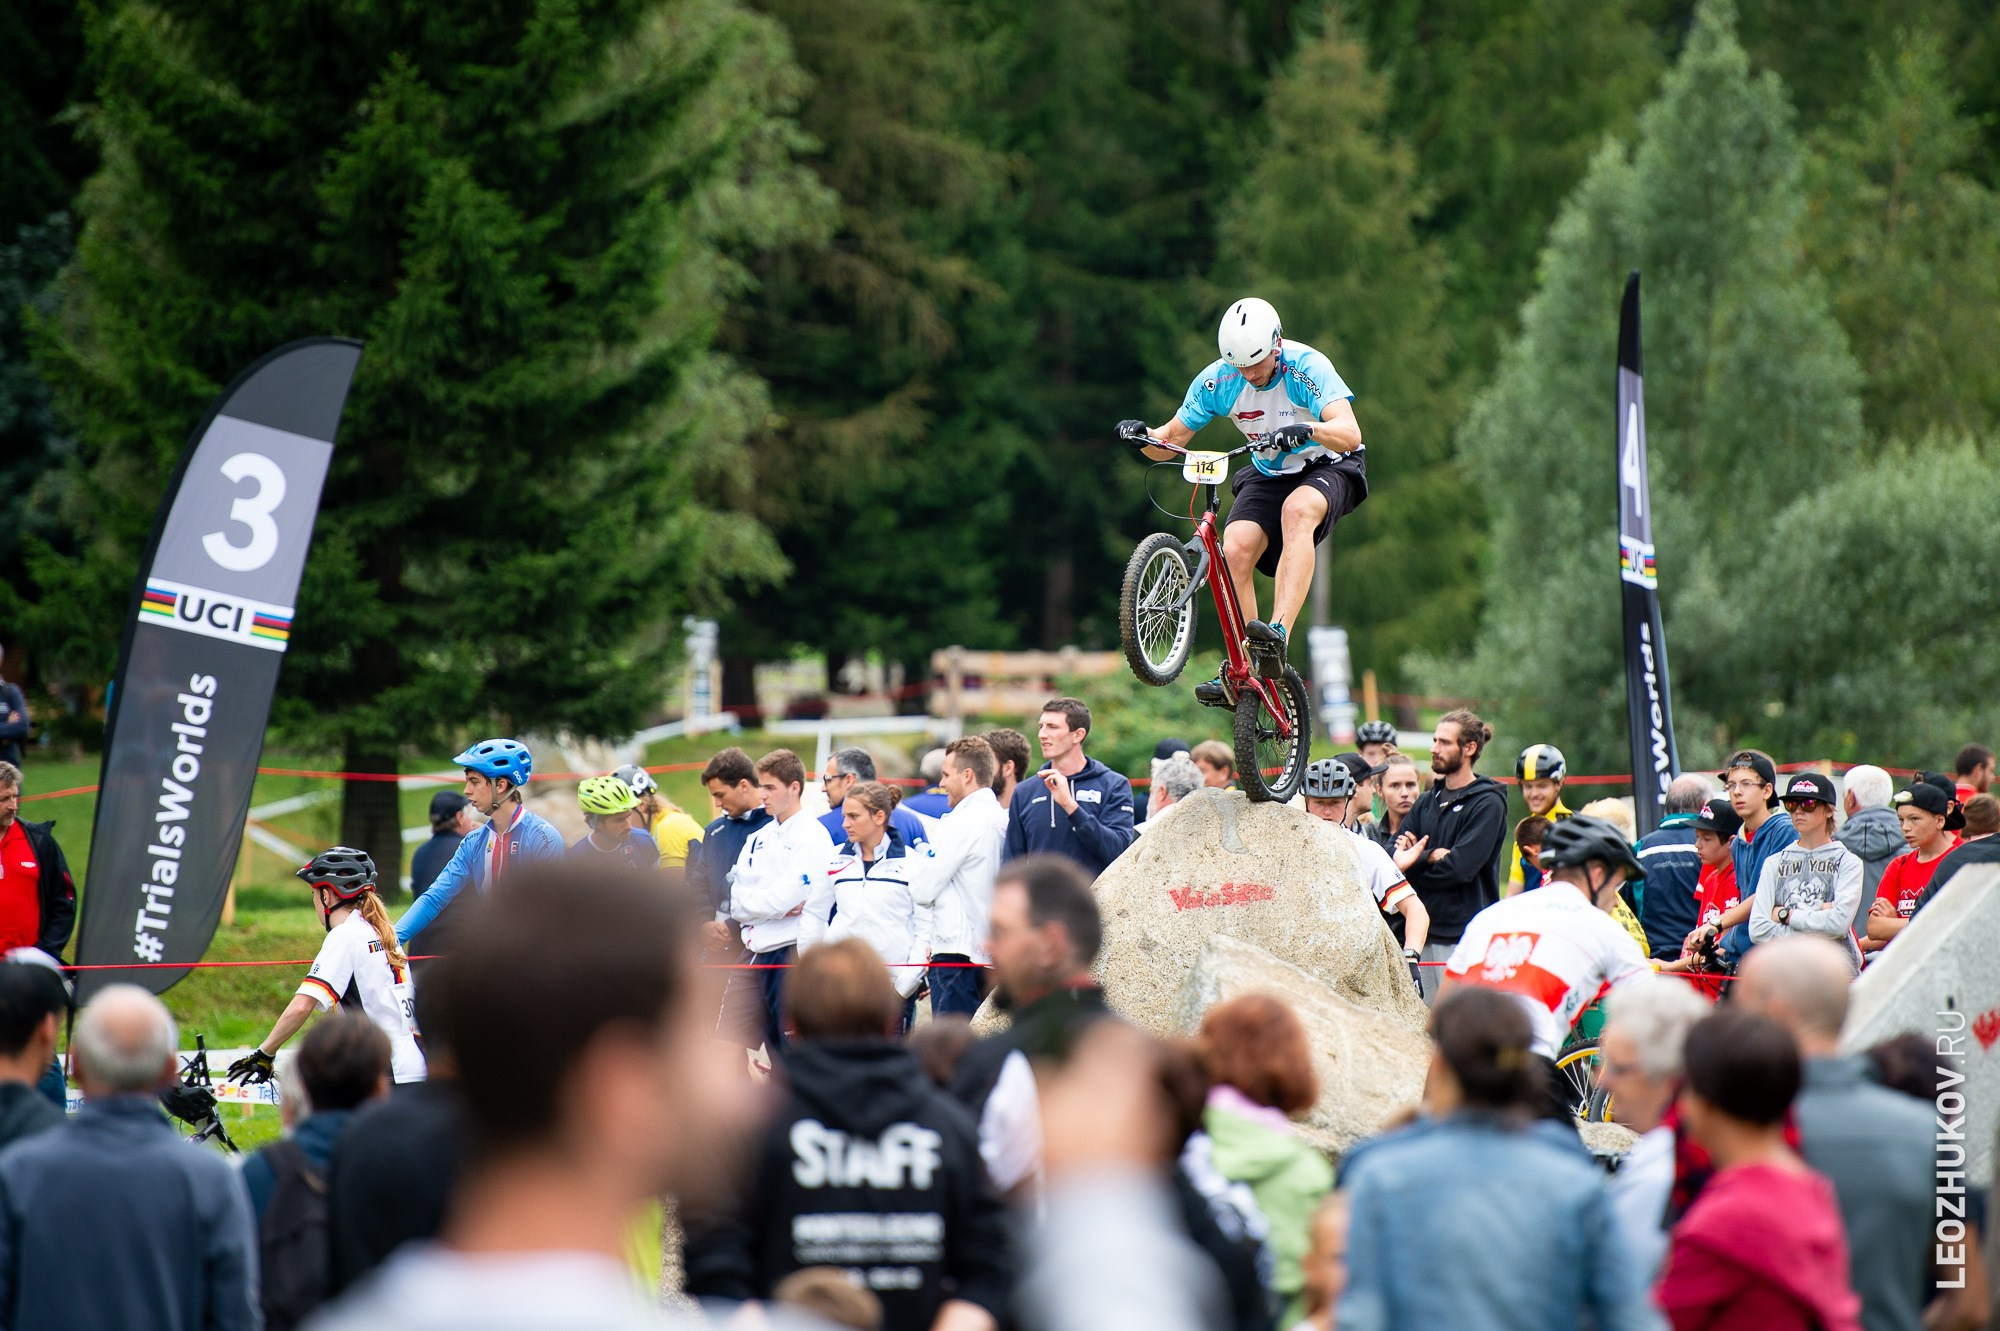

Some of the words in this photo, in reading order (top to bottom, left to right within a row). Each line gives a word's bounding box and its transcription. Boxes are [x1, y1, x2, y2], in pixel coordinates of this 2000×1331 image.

[202, 452, 286, 571] 3
[1196, 461, 1215, 474] 114
[1622, 402, 1642, 518] 4
[179, 594, 245, 633] UCI
[1640, 621, 1673, 805] lsWorlds
[133, 673, 218, 963] #TrialsWorlds
[790, 1118, 943, 1190] STAFF
